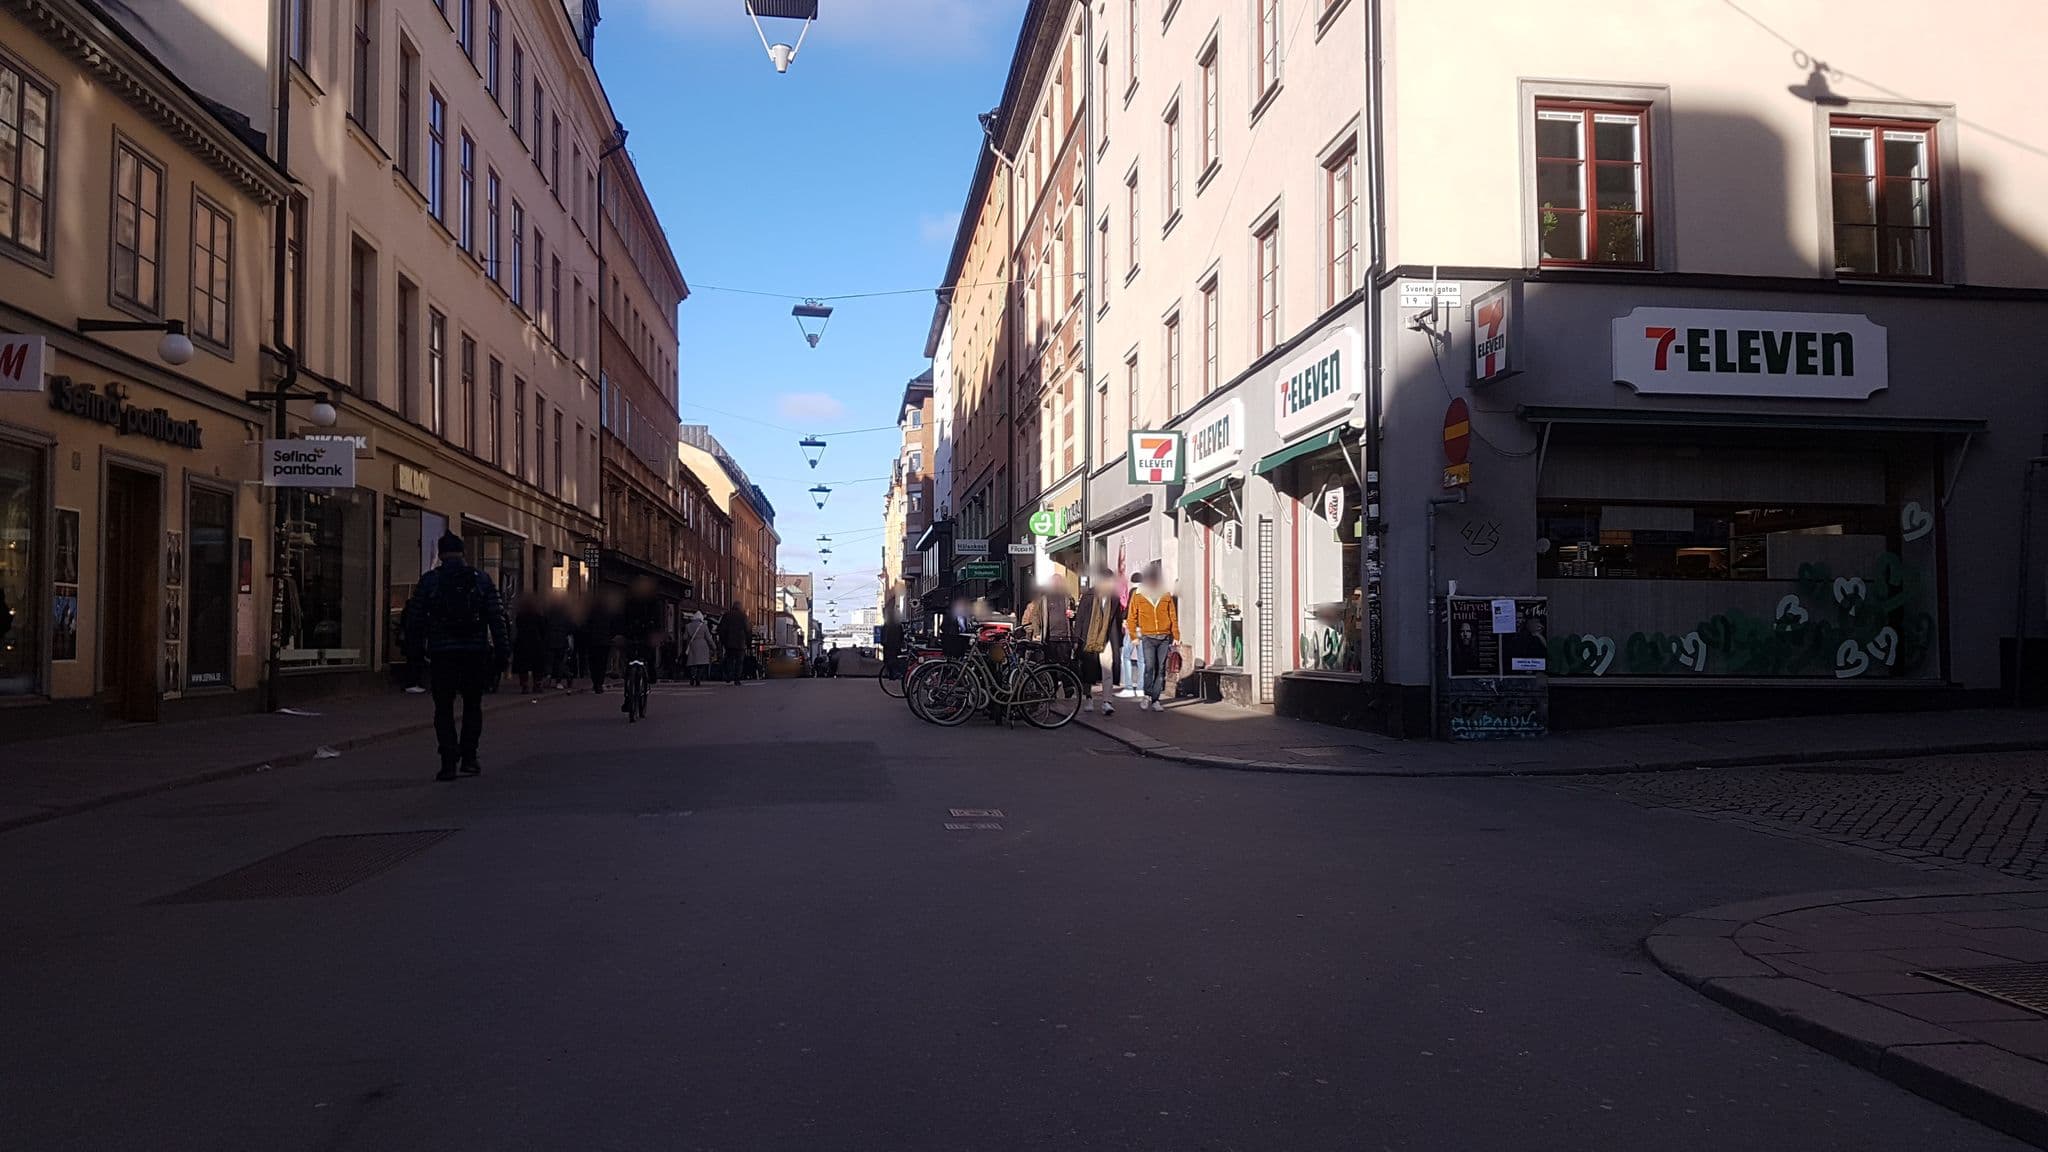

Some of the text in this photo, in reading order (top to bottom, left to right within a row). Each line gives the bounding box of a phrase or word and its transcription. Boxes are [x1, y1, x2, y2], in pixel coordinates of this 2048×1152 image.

[1405, 284, 1457, 294] Svartengatan
[274, 450, 317, 462] Sefina
[273, 464, 343, 477] pantbank
